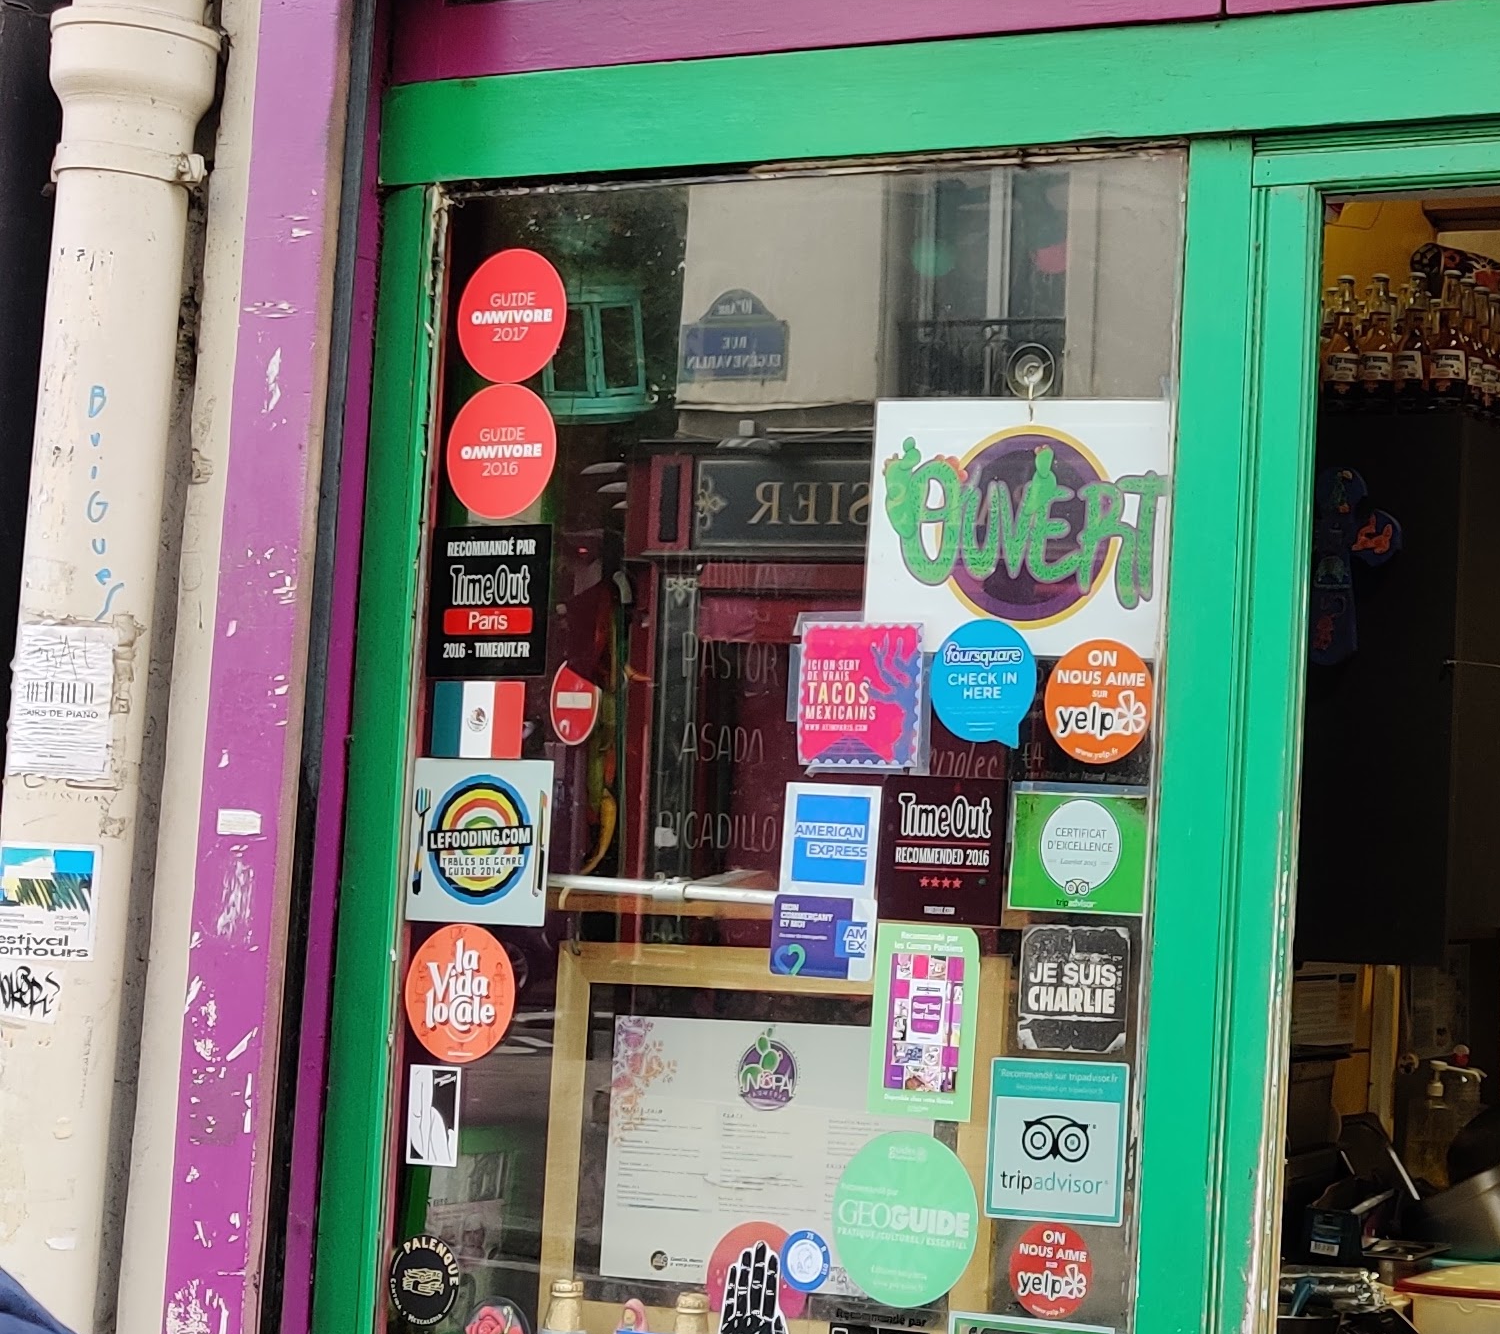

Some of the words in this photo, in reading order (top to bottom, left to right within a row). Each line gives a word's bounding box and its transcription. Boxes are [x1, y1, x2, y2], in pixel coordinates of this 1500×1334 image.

[490, 292, 536, 307] GUIDE
[492, 327, 529, 342] 2017
[479, 426, 525, 442] GUIDE
[481, 462, 519, 477] 2016
[447, 537, 514, 557] RECOMMANDÉ
[516, 539, 536, 555] PAR
[450, 564, 495, 605] Time
[494, 564, 530, 605] Out
[468, 611, 508, 631] Paris
[443, 642, 466, 658] 2016
[474, 642, 530, 658] TIMEOUT.FR
[938, 642, 1024, 668] foursquare
[1088, 650, 1117, 667] ON
[808, 659, 821, 671] ICI
[823, 659, 836, 671] ON
[838, 659, 860, 671] SERT
[807, 671, 818, 681] DE
[822, 671, 850, 681] VRAIS
[948, 672, 998, 686] CHECK
[1002, 672, 1018, 684] IN
[1057, 670, 1102, 685] NOUS
[1105, 672, 1146, 687] AIME
[807, 681, 870, 705] TACOS
[963, 686, 1002, 699] HERE
[66, 710, 99, 720] PIANO
[805, 705, 877, 721] MEXICAINS
[1056, 703, 1115, 740] yelp
[679, 722, 765, 764] ASADA
[898, 792, 951, 838] Time
[951, 794, 993, 839] Out
[430, 827, 531, 850] LEFOODING.COM
[794, 824, 864, 840] AMERICAN
[1055, 826, 1108, 840] CERTIFICAT
[808, 843, 868, 859] EXPRESS
[1046, 839, 1114, 853] D'EXCELLENCE
[442, 857, 476, 866] TABLES
[479, 856, 490, 866] DE
[895, 845, 964, 866] RECOMMENDED
[965, 848, 990, 867] 2016
[448, 867, 476, 876] GUIDE
[480, 866, 502, 876] 2014
[454, 937, 480, 974] la
[426, 961, 490, 1003] Vida
[1028, 961, 1058, 985] JE
[1061, 961, 1117, 988] SUIS
[1027, 985, 1117, 1015] CHARLIE
[1000, 1170, 1104, 1196] tripadvisor
[837, 1198, 971, 1239] GEOGUIDE
[1042, 1230, 1066, 1246] ON
[403, 1236, 460, 1287] PALENQUE
[1019, 1243, 1054, 1259] NOUS
[1055, 1248, 1088, 1263] AIME
[1018, 1271, 1063, 1300] yelp
